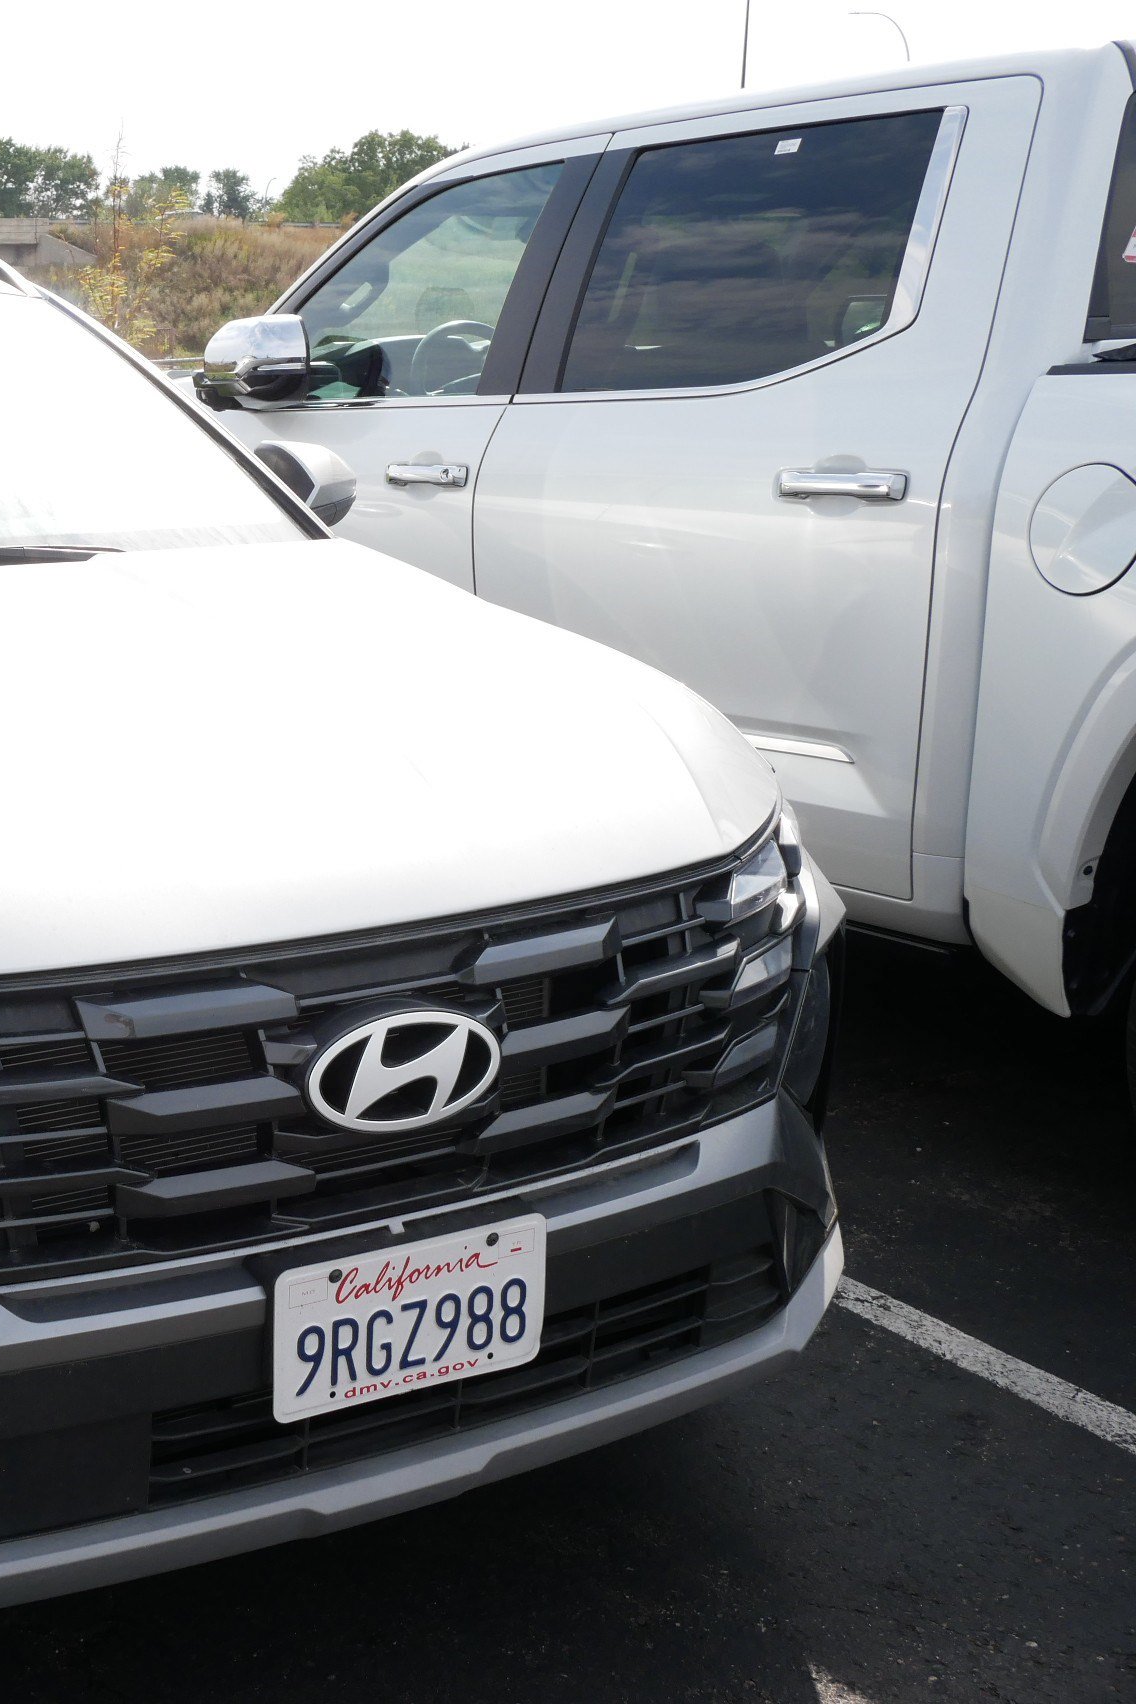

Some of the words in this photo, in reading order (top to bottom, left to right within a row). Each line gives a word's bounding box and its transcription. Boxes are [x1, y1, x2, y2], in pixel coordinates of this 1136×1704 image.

[335, 1245, 499, 1305] California
[295, 1277, 527, 1398] 9RGZ988
[344, 1357, 480, 1400] dmv.ca.gov
